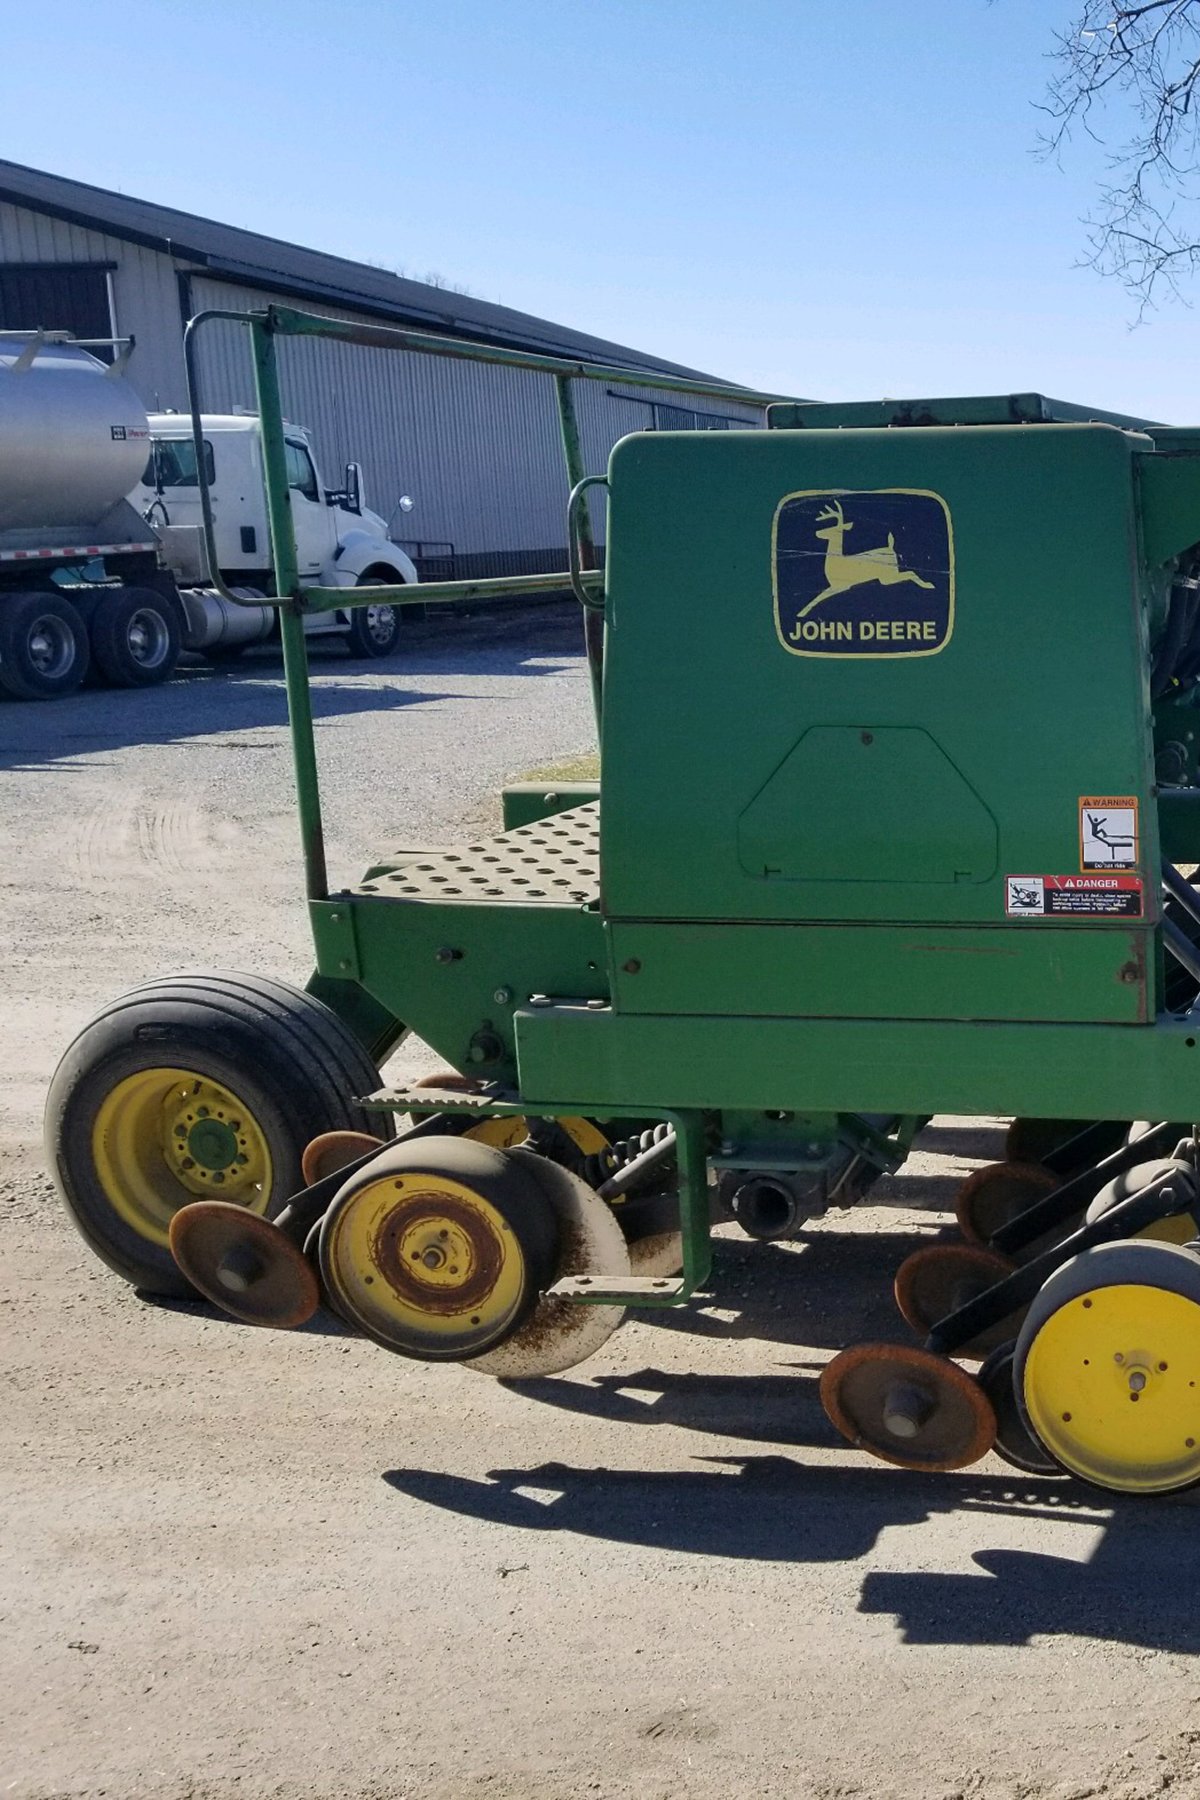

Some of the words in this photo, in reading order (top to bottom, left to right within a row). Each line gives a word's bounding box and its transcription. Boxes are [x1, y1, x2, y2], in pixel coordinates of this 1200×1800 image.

[789, 620, 853, 641] JOHN
[859, 621, 937, 641] DEERE
[1093, 799, 1135, 807] WARNING
[1076, 879, 1118, 888] DANGER
